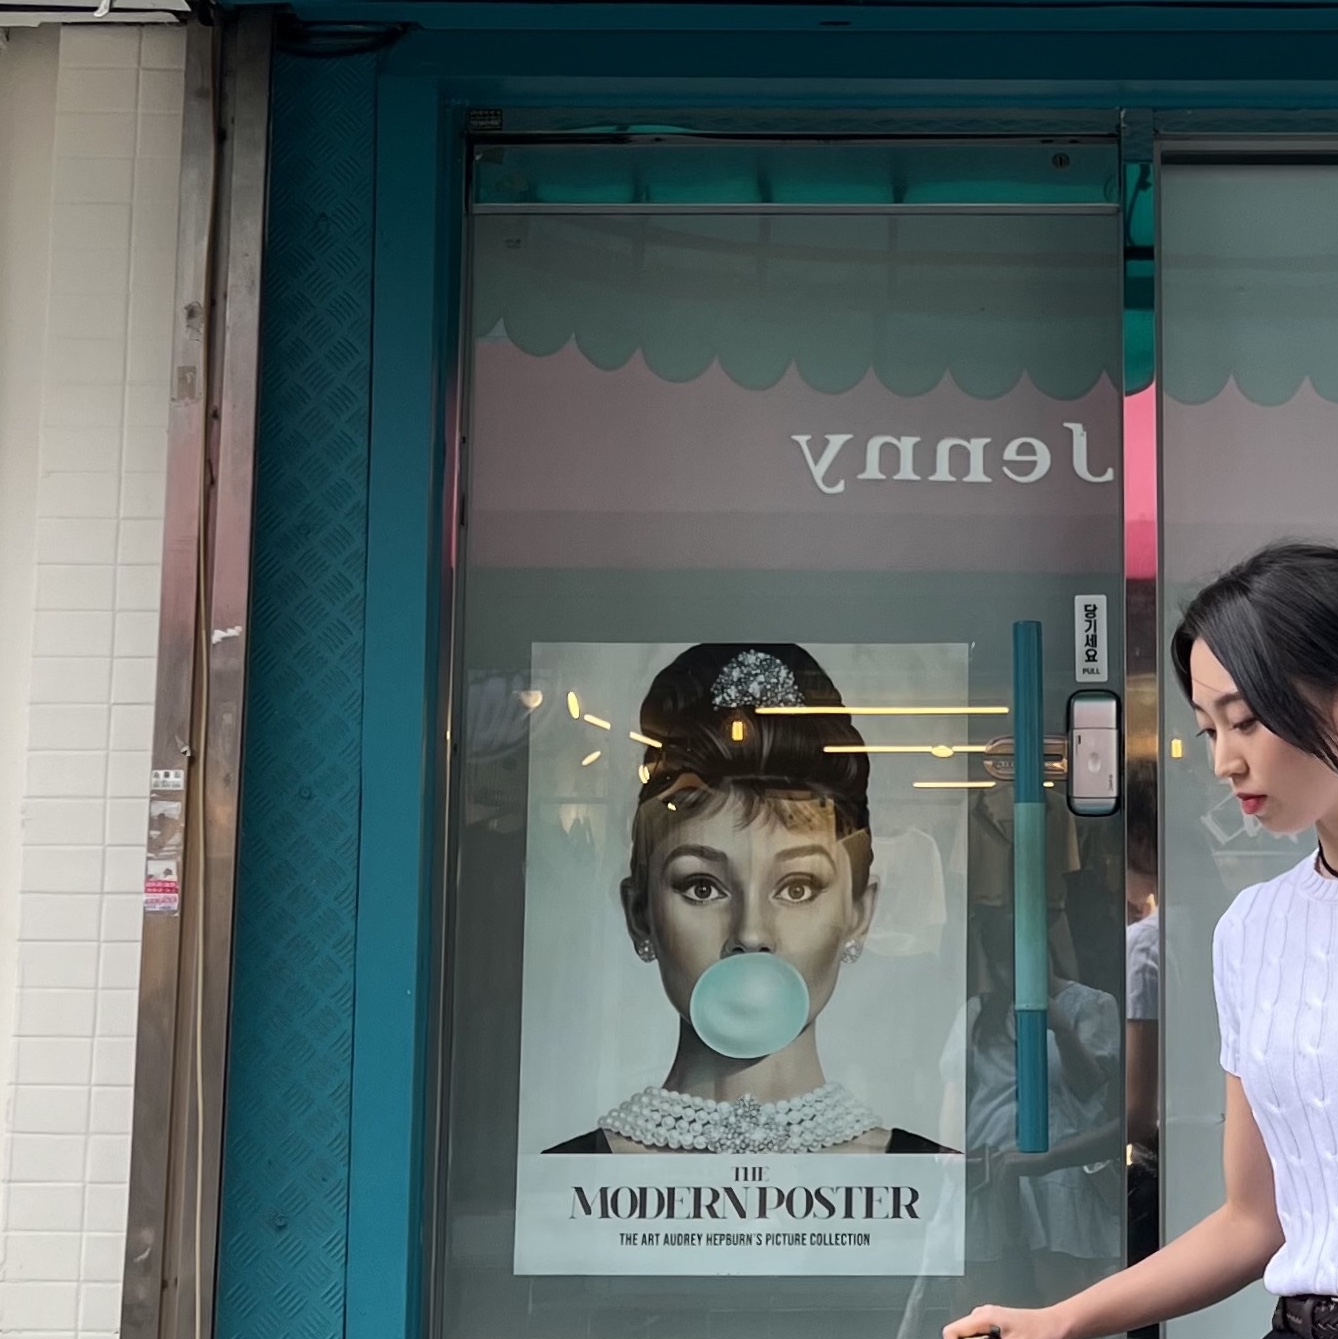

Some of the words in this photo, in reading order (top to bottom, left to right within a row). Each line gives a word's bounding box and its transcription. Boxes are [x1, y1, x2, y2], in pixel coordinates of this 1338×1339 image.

[1084, 604, 1098, 663] 당기세요
[731, 1166, 769, 1183] THE
[570, 1186, 749, 1220] MODERN
[757, 1186, 921, 1220] POSTER
[619, 1232, 638, 1246] THE
[641, 1232, 660, 1246] ART
[663, 1232, 703, 1246] AUDREY
[706, 1232, 762, 1247] HEPBURN'S
[765, 1232, 807, 1247] PICTURE
[809, 1232, 871, 1247] COLLECTION
